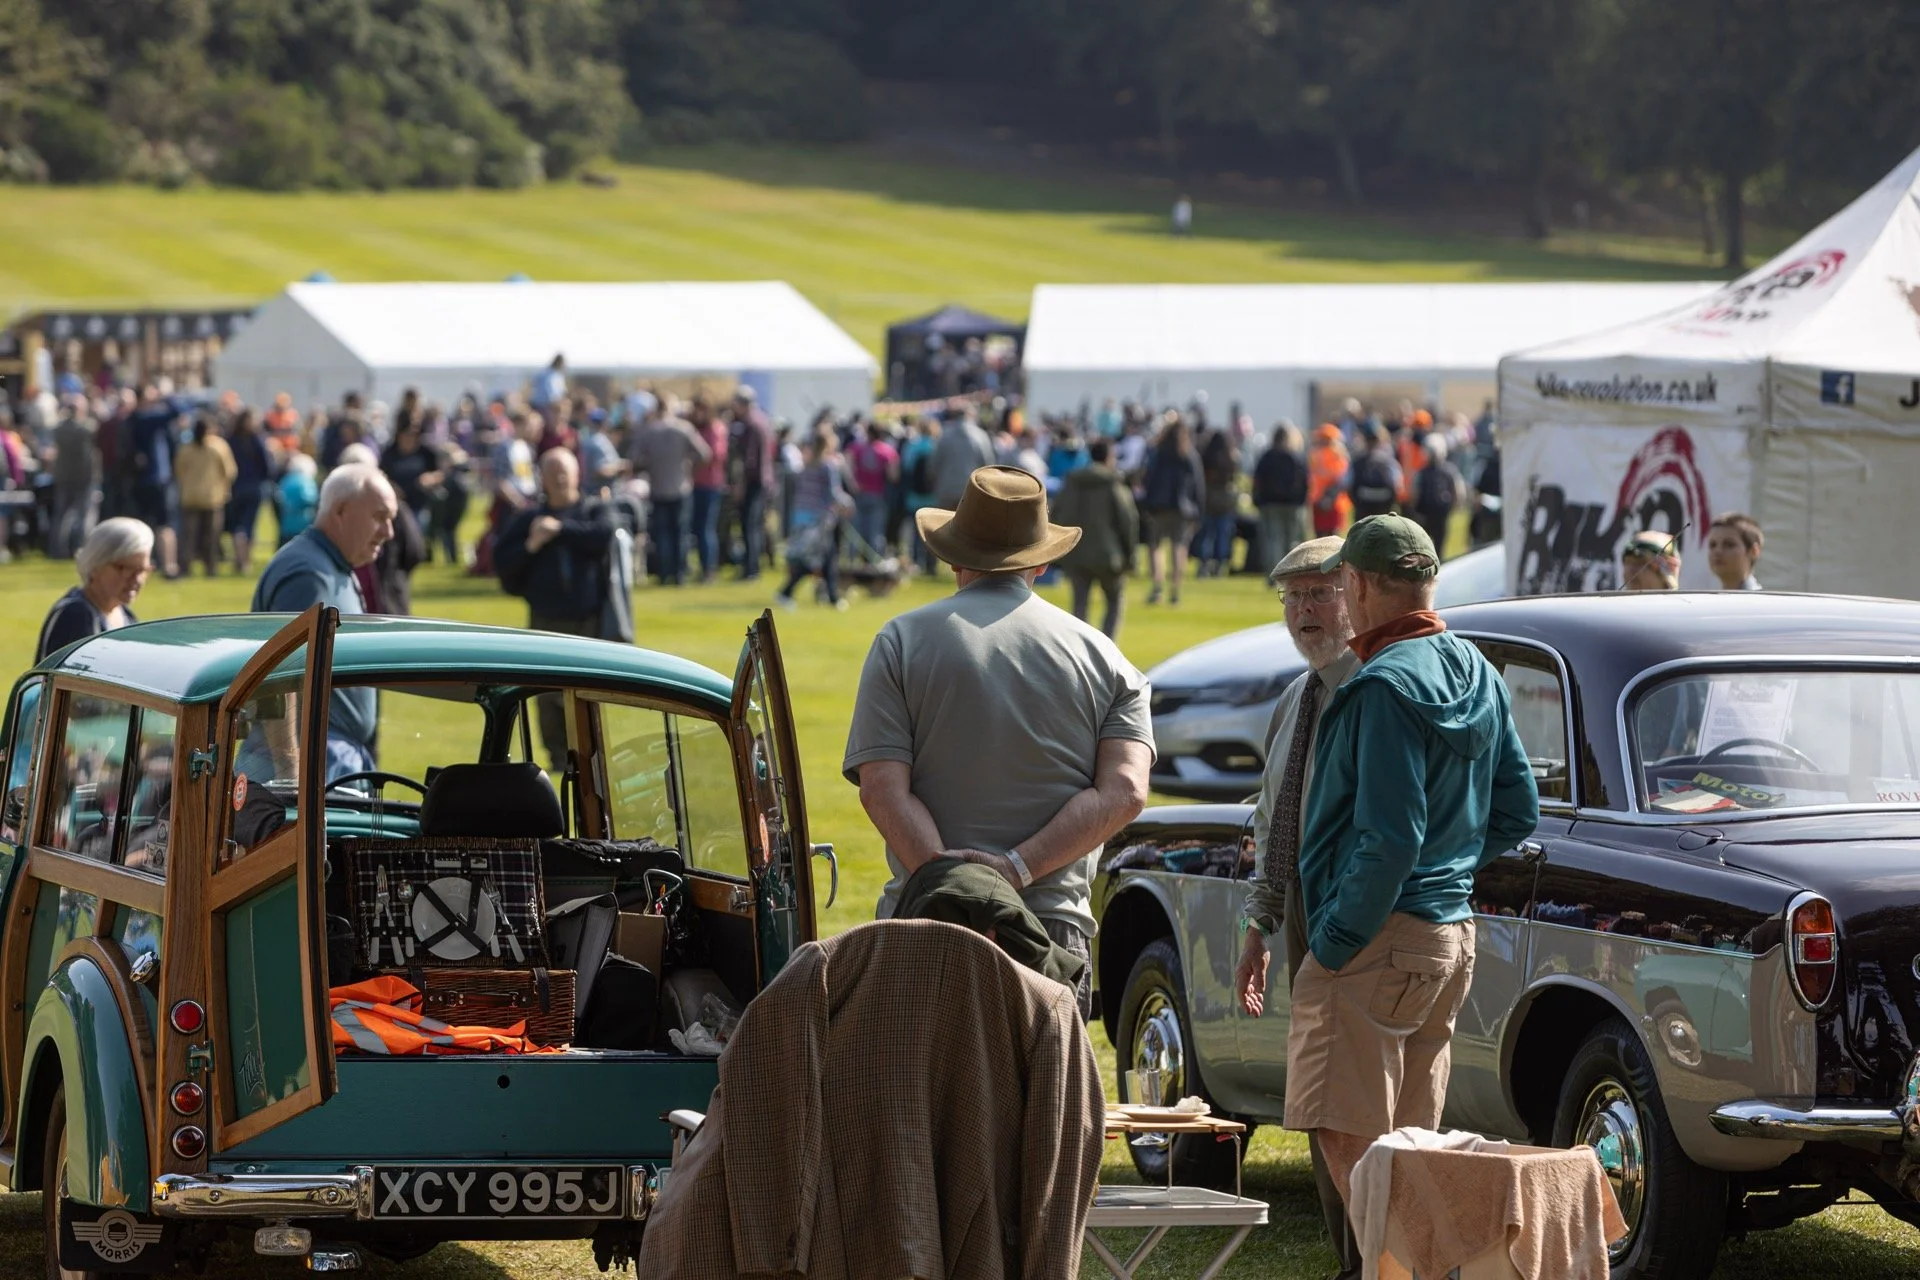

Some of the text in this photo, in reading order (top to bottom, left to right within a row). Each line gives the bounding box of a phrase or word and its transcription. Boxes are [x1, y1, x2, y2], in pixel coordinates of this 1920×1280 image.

[379, 1171, 617, 1213] XCY 995J
[95, 1240, 140, 1260] MORRIS
